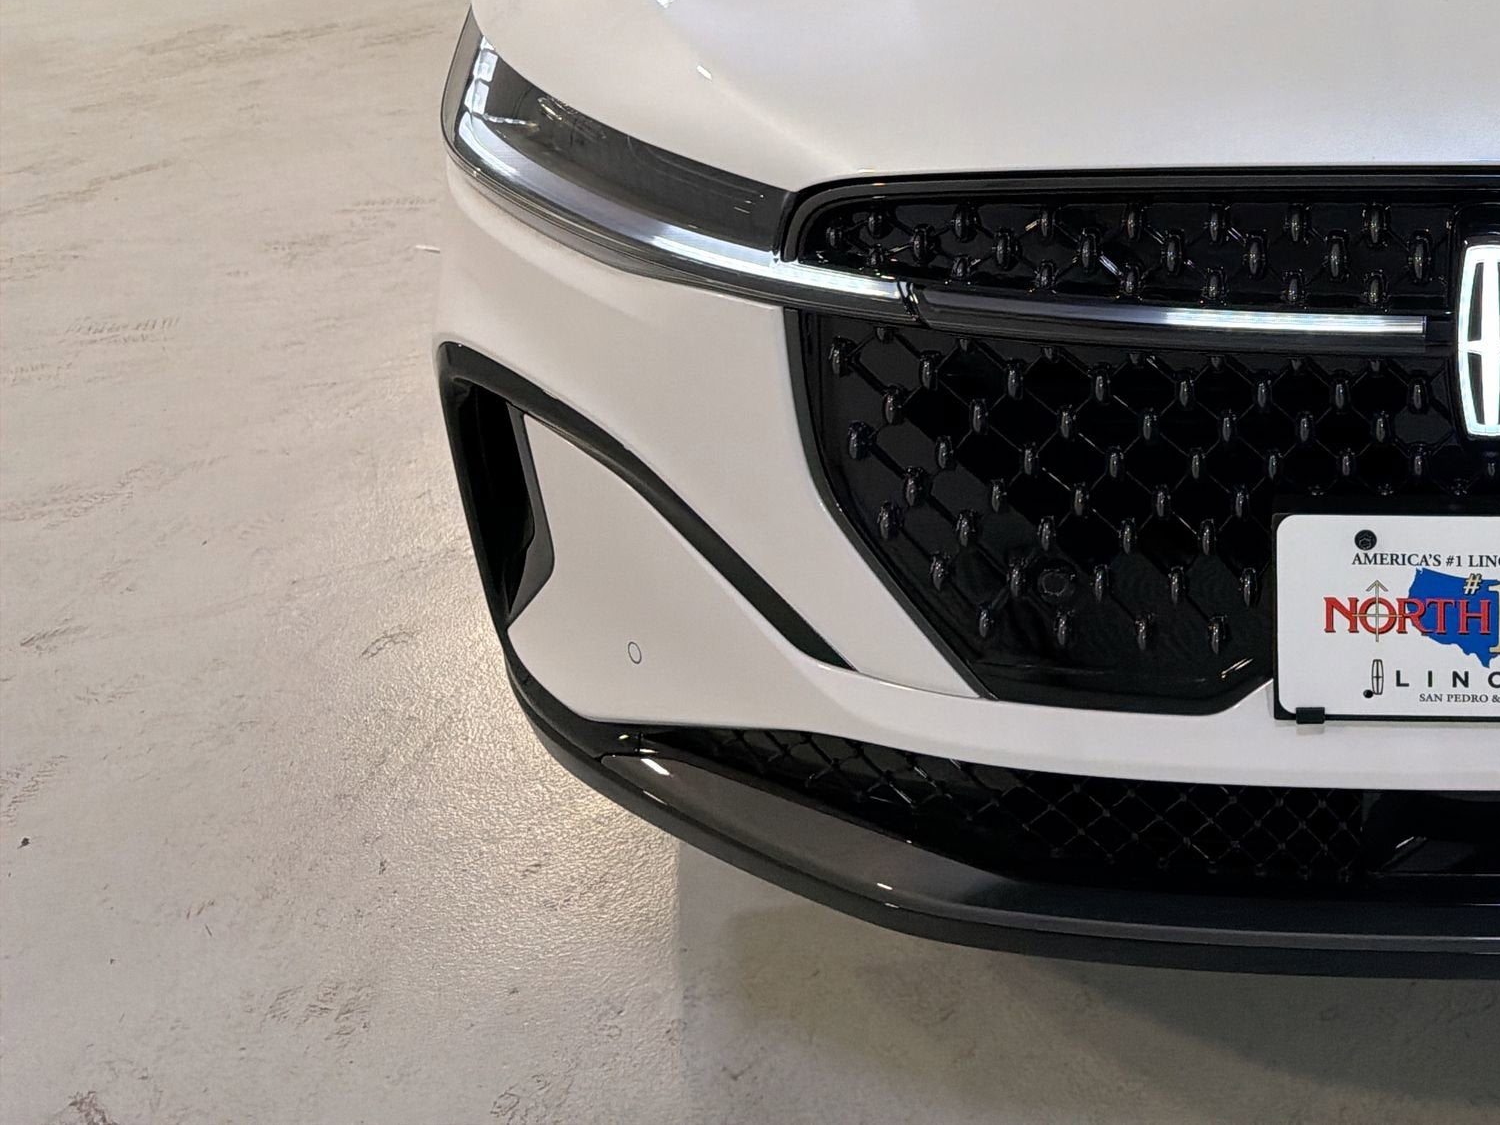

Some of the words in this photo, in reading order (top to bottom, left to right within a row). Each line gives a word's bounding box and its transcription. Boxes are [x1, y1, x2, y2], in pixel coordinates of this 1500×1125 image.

[1352, 553, 1442, 567] AMERICA'S
[1446, 555, 1463, 567] #1
[1324, 596, 1490, 635] NORTH
[1419, 693, 1445, 703] SAN
[1447, 693, 1489, 703] PEDRO
